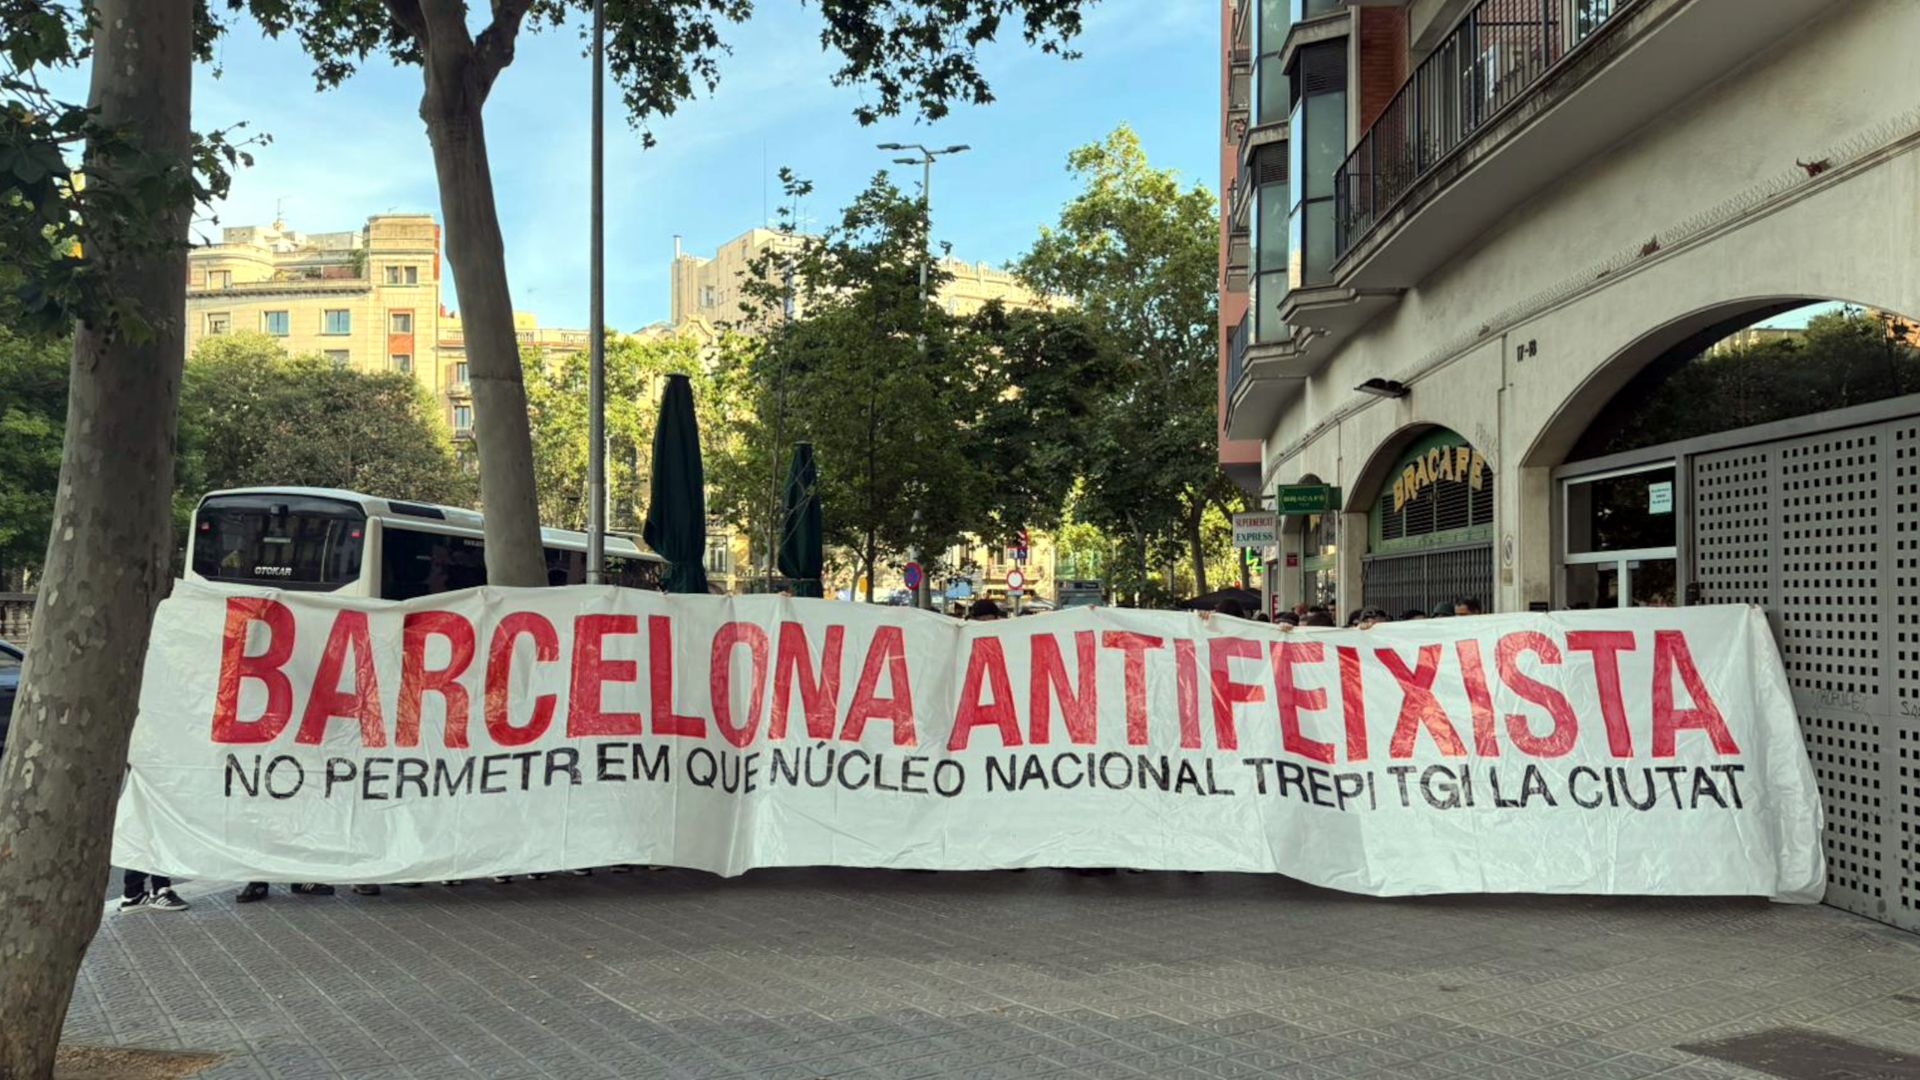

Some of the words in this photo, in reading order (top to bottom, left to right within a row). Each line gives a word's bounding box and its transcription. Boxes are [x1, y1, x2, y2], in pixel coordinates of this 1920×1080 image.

[1236, 532, 1274, 542] EXPRESS
[254, 566, 293, 577] OTOKAR
[212, 596, 916, 750] BARCELONA
[949, 629, 1739, 764] ANTIFEIXISTA
[225, 753, 305, 800] NO
[686, 746, 760, 795] QUE
[770, 740, 965, 798] NÚCLEO
[986, 751, 1234, 796] NACIONAL
[1489, 764, 1558, 809] LA
[1569, 764, 1745, 812] CIUTAT
